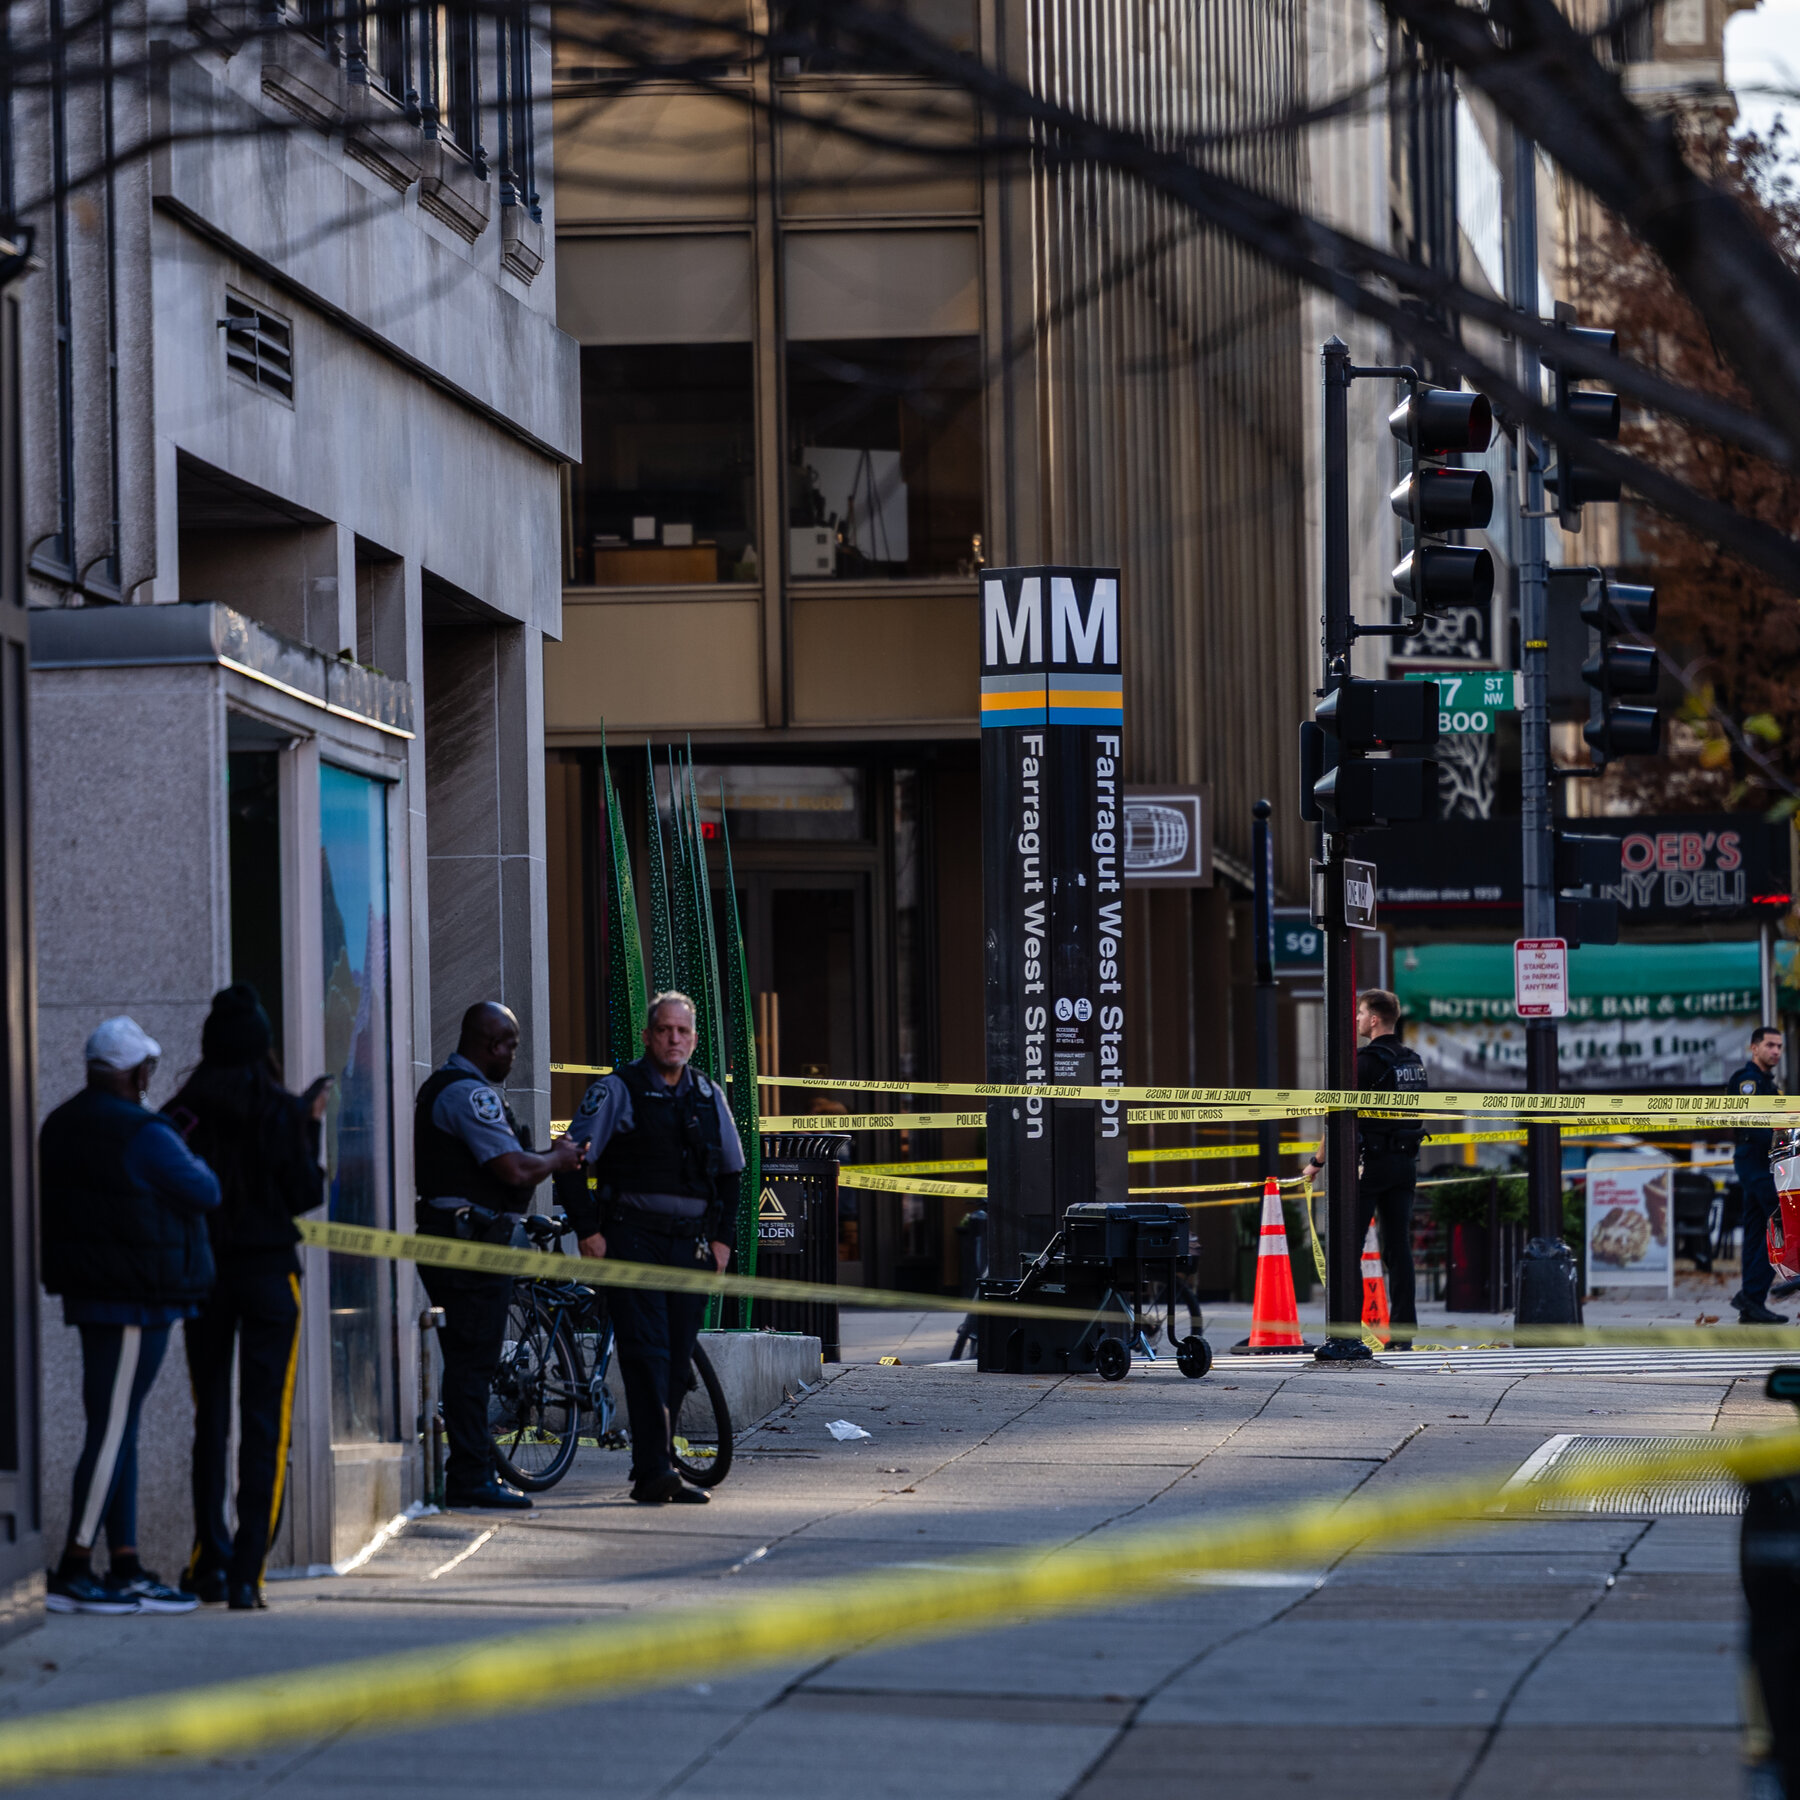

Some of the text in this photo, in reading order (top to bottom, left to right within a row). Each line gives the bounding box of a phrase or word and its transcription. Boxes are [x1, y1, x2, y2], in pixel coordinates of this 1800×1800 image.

[984, 577, 1042, 665] M
[1051, 577, 1118, 664] M
[1485, 679, 1503, 690] ST
[1484, 693, 1503, 705] NW
[1092, 735, 1120, 893] Farragut
[1621, 832, 1741, 871] OEB'S
[1388, 887, 1438, 900] Tradition
[1665, 871, 1744, 906] DELI
[1018, 735, 1047, 1139] Farragut West Station
[1099, 901, 1122, 994] West
[1286, 933, 1317, 955] sg
[1430, 999, 1513, 1017] BOTTO
[1603, 995, 1649, 1015] BAR
[1656, 994, 1675, 1013] &
[1684, 992, 1758, 1011] GRILL
[1558, 1038, 1642, 1061] ottom
[1100, 1006, 1124, 1138] Station
[1396, 1067, 1426, 1082] POLICE
[792, 1116, 894, 1128] POLICE LINE DO NOT CROSS
[956, 1114, 982, 1126] POLICE
[1127, 1109, 1223, 1122] OLICE LINE DO NOT CROSS
[1286, 1108, 1312, 1116] POLICE
